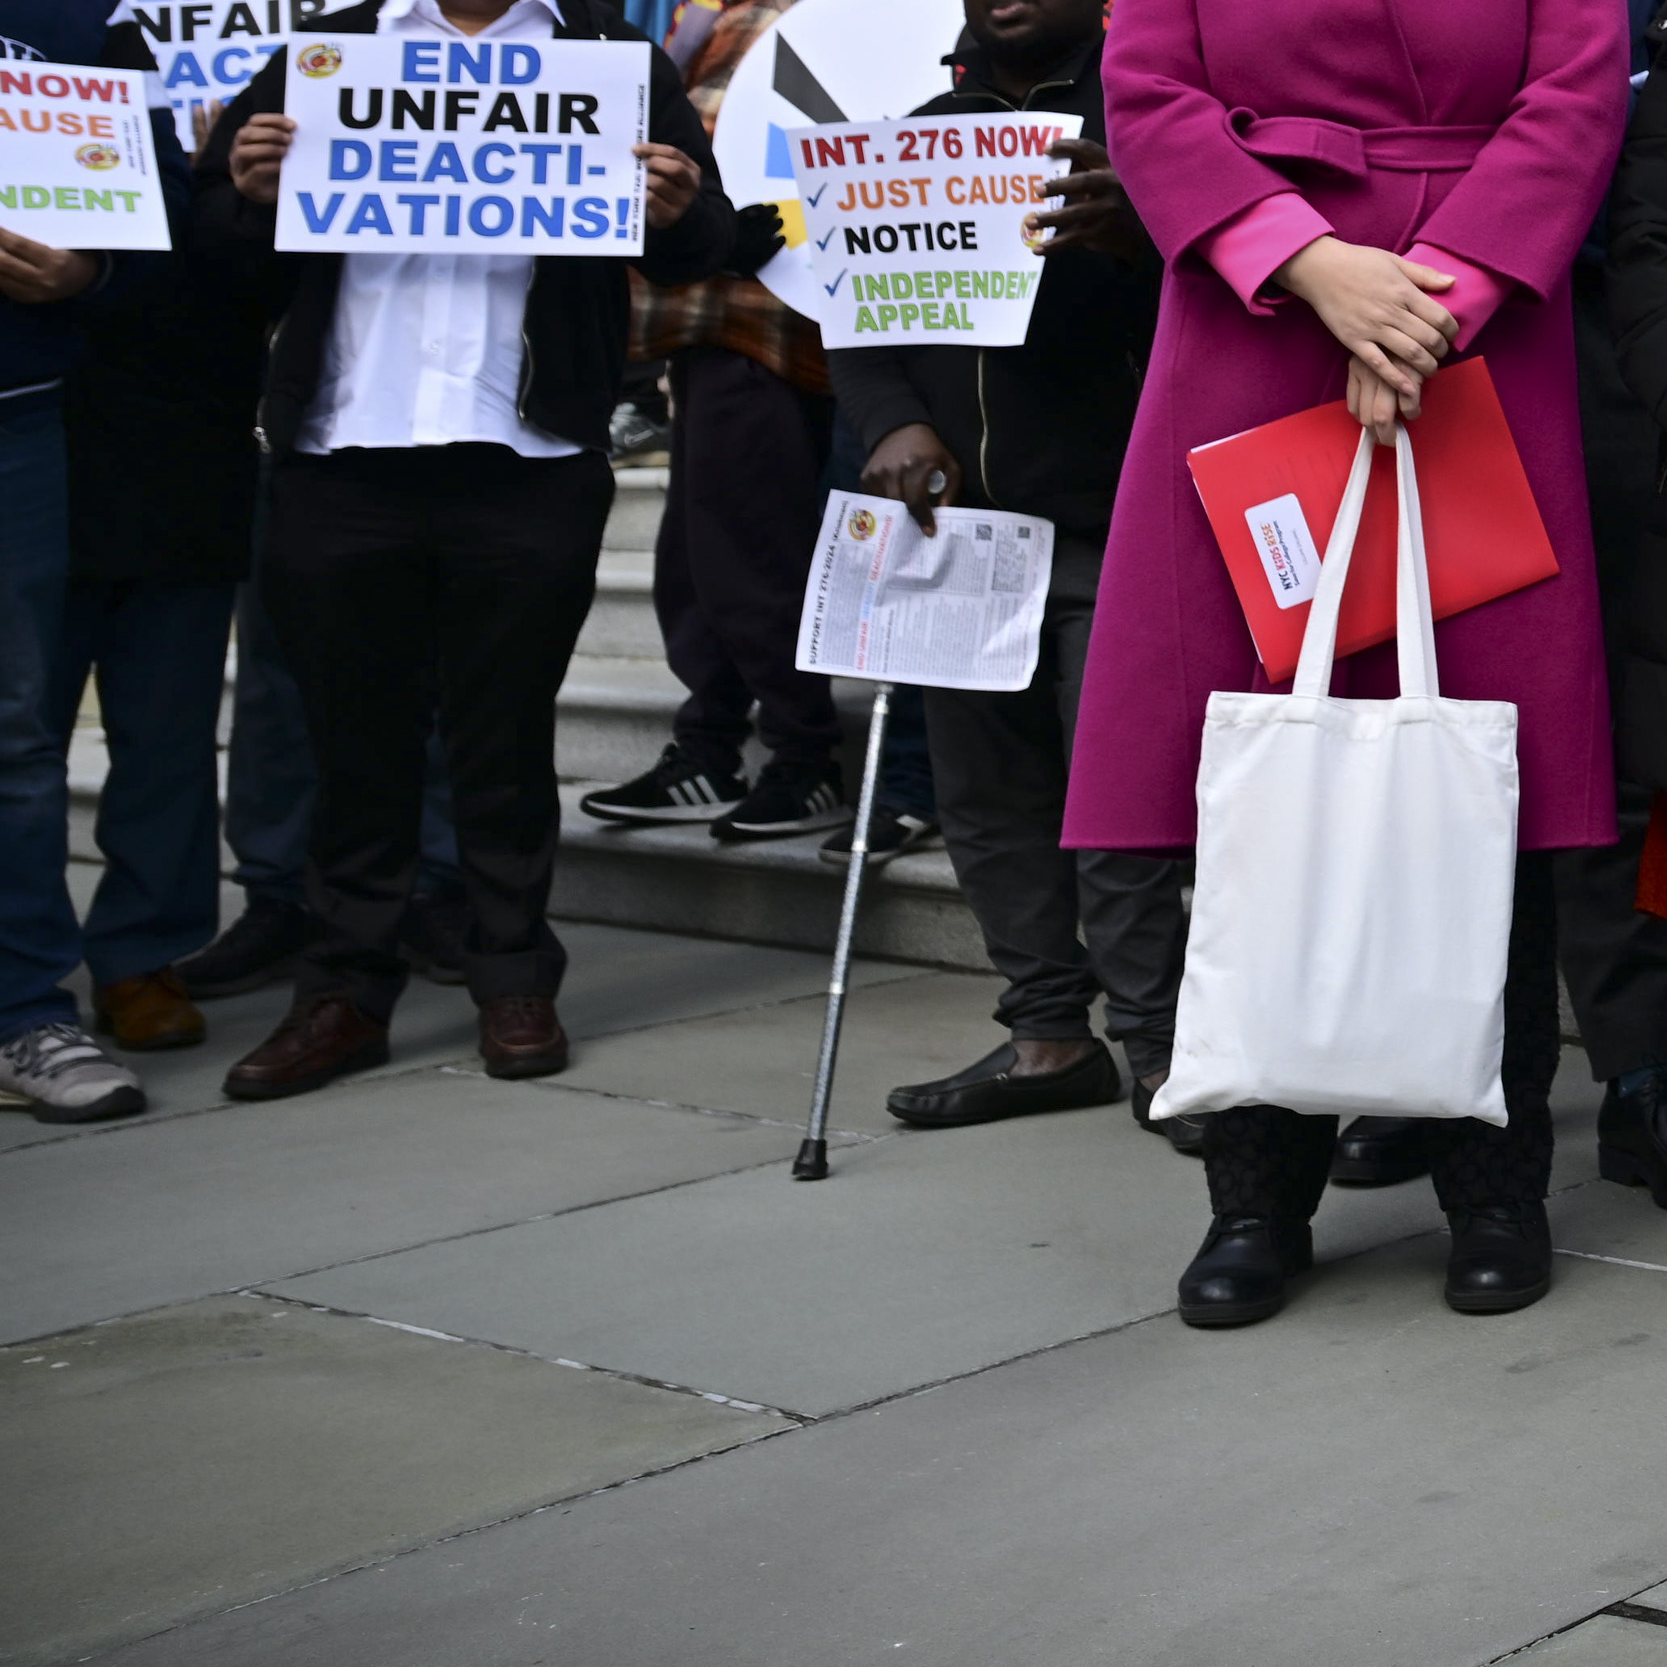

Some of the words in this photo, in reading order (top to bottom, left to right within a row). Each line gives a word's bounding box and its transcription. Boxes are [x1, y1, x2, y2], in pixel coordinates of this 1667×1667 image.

[402, 41, 541, 85] END
[338, 88, 600, 134] UNFAIR
[328, 139, 606, 185] DEACTI-
[800, 133, 885, 168] INT.
[896, 128, 964, 162] 276
[974, 126, 1063, 157] NOW!
[296, 191, 630, 238] VATIONS!
[836, 178, 932, 212] JUST
[945, 175, 1045, 205] CAUSE
[843, 222, 978, 255] NOTICE
[852, 271, 1038, 302] INDEPENDENT
[854, 303, 974, 333] APPEAL
[1279, 570, 1293, 590] NYC
[809, 616, 821, 664] SUPPORT
